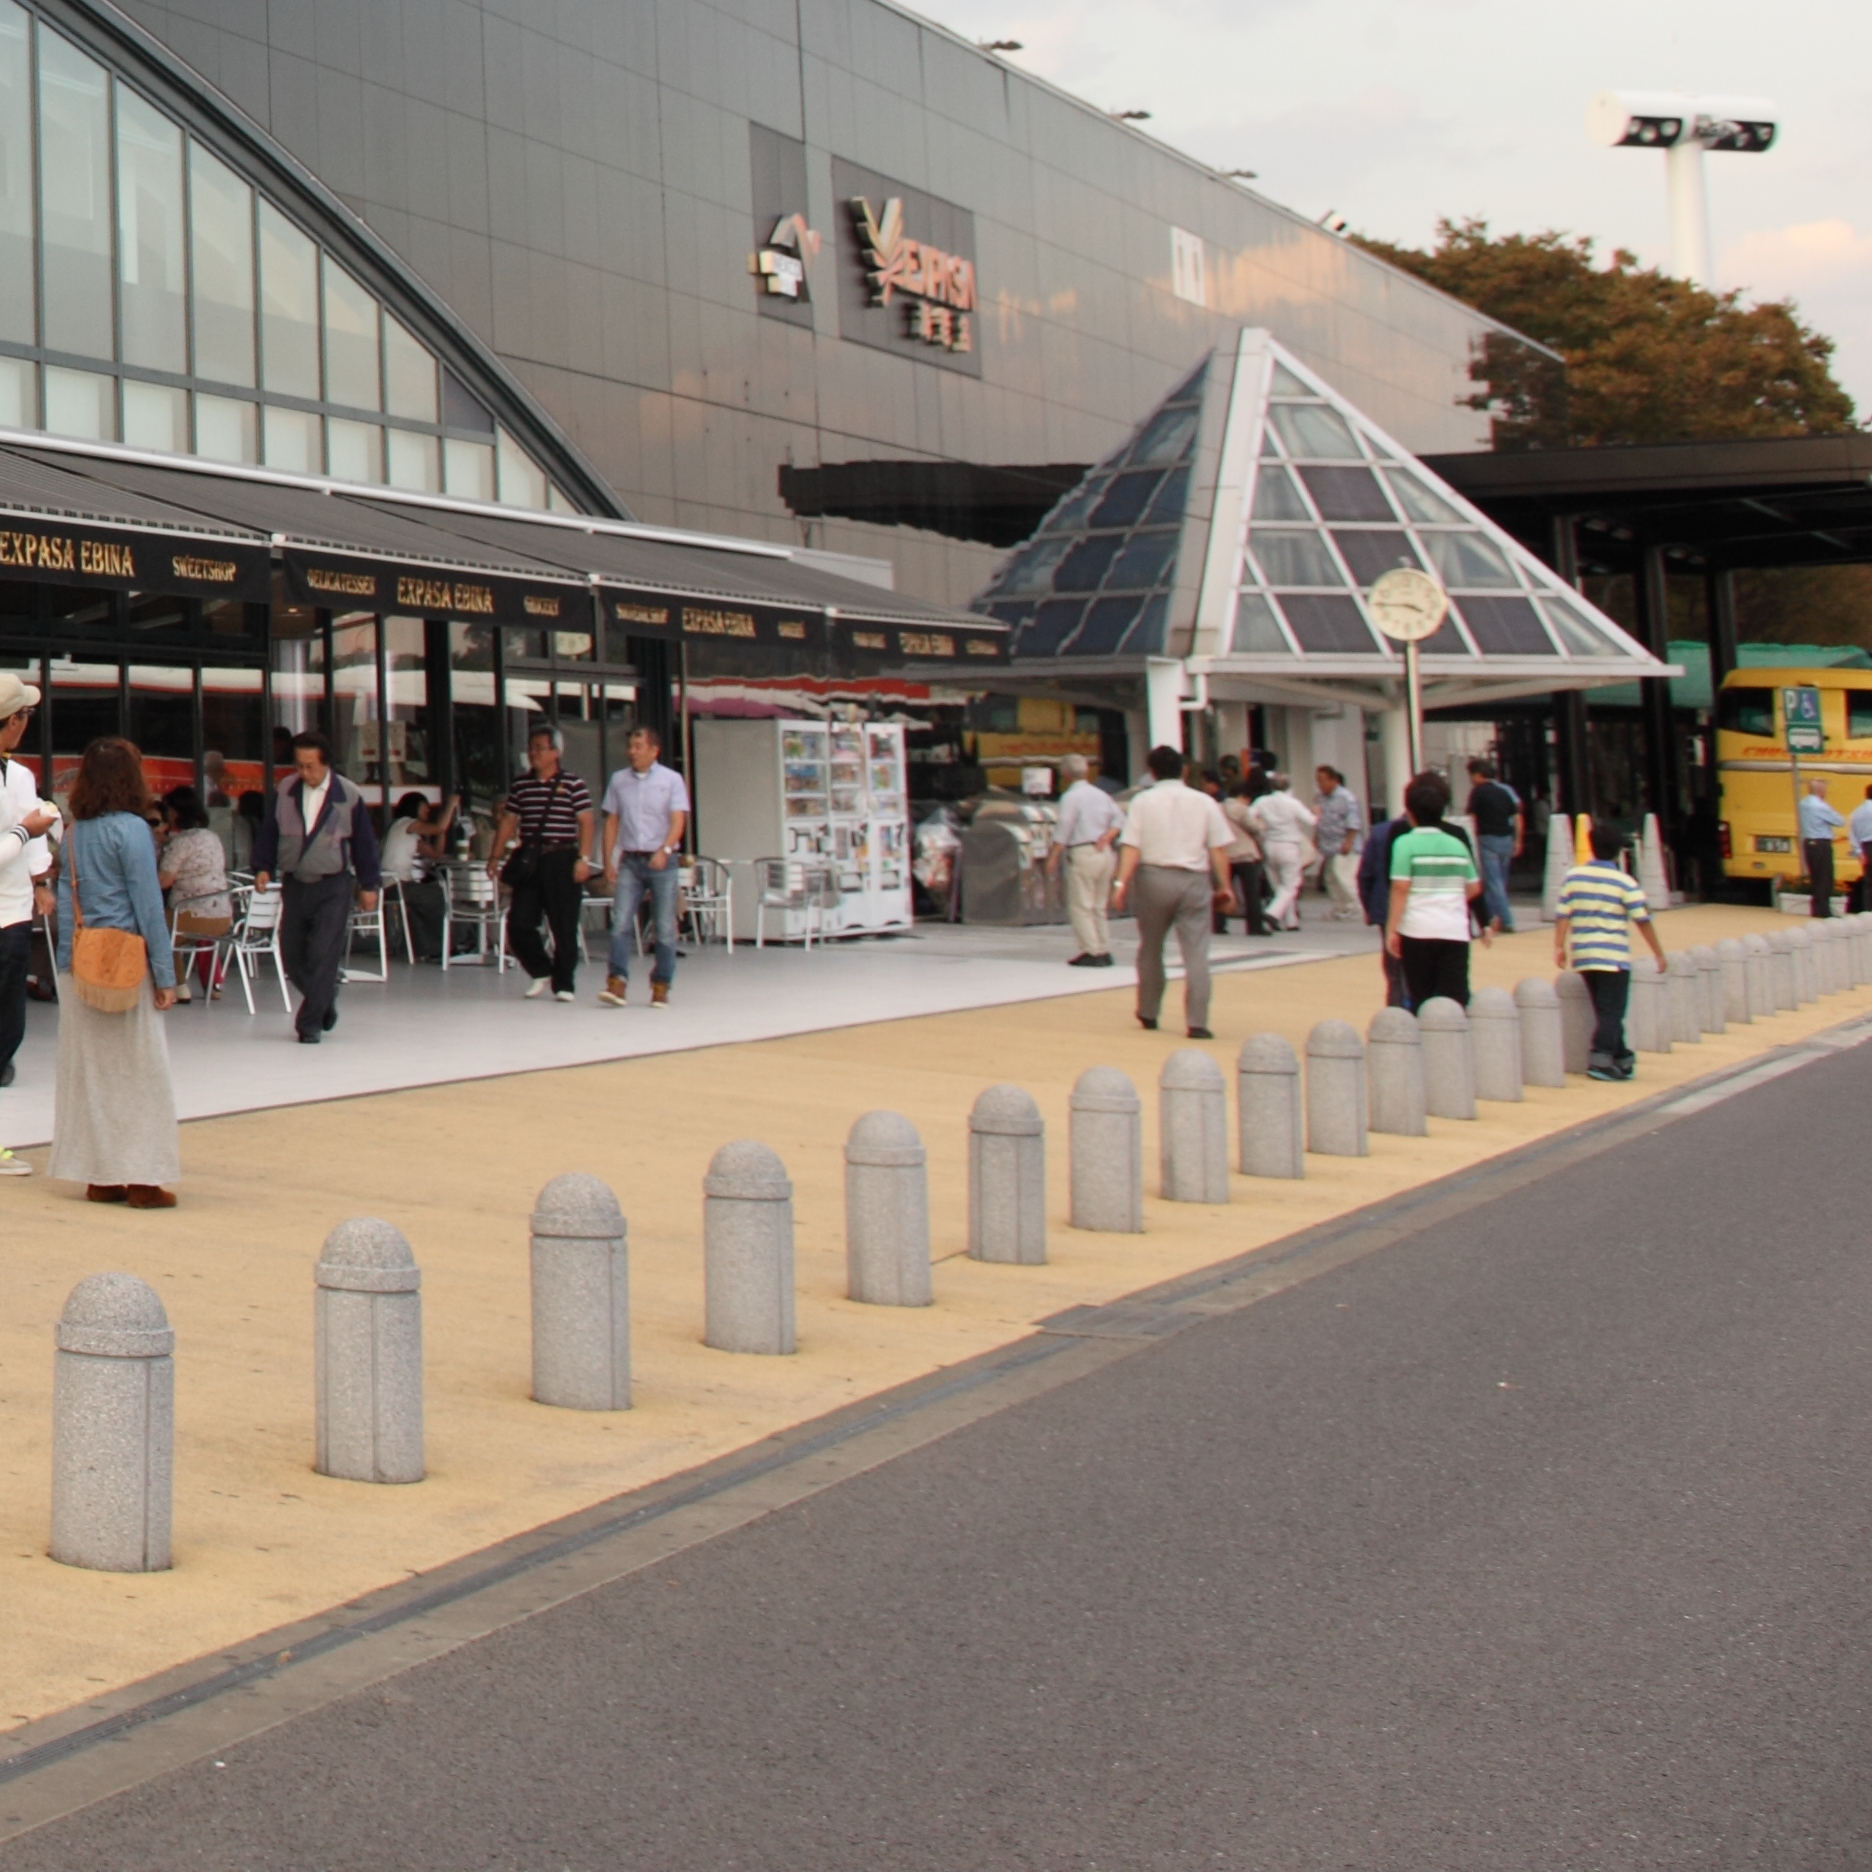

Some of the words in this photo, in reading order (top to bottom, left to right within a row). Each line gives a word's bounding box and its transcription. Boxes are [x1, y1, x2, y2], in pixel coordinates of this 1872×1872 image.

[80, 539, 135, 577] EBINA
[172, 554, 237, 582] SWEETSHOP
[397, 576, 453, 609] EXPASA
